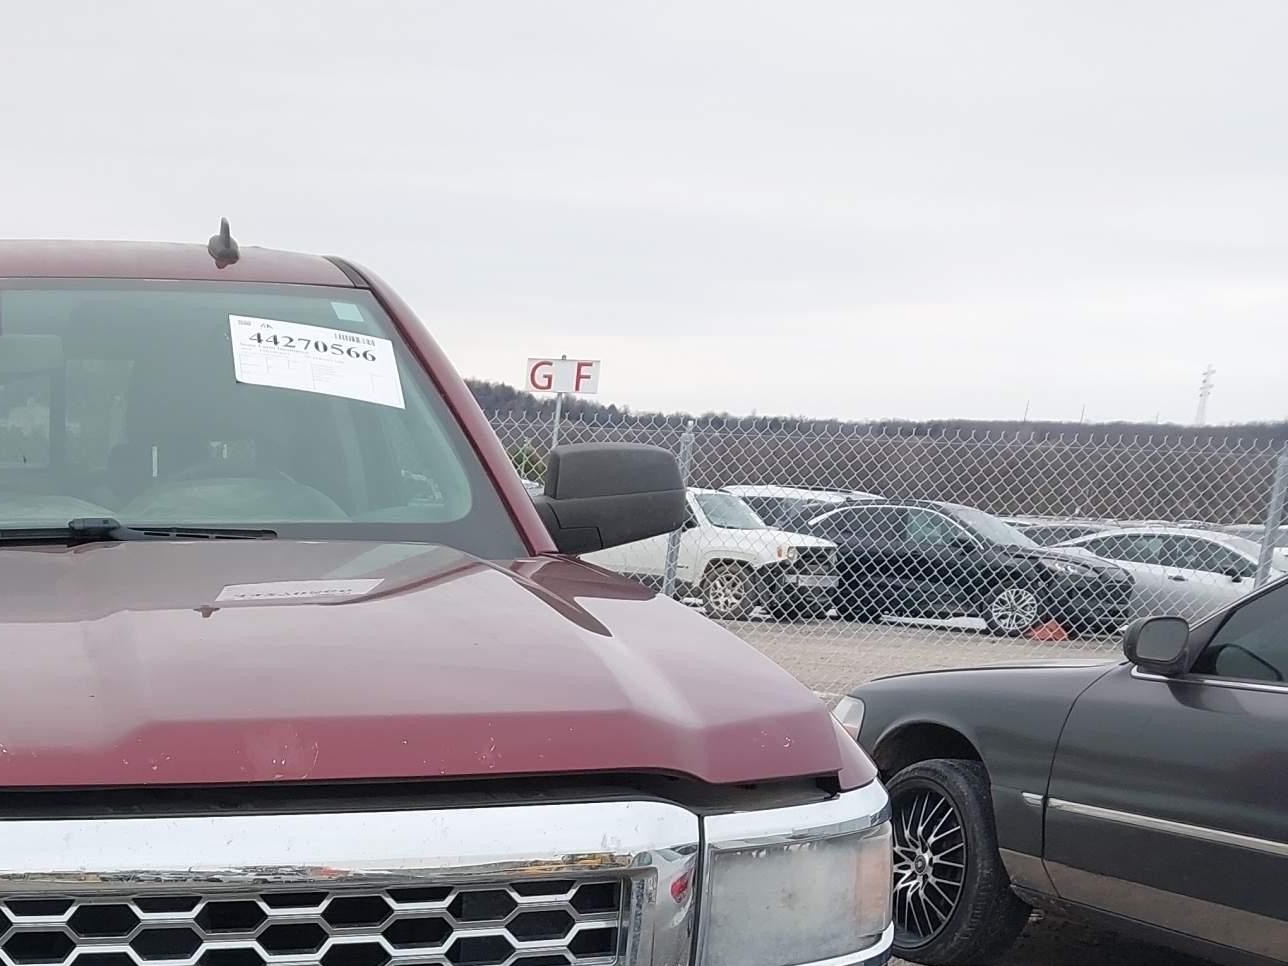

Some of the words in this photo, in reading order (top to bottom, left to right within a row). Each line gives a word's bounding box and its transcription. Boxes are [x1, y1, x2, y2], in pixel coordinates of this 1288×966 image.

[248, 331, 377, 362] 44270566
[530, 360, 553, 390] G
[575, 362, 593, 391] F
